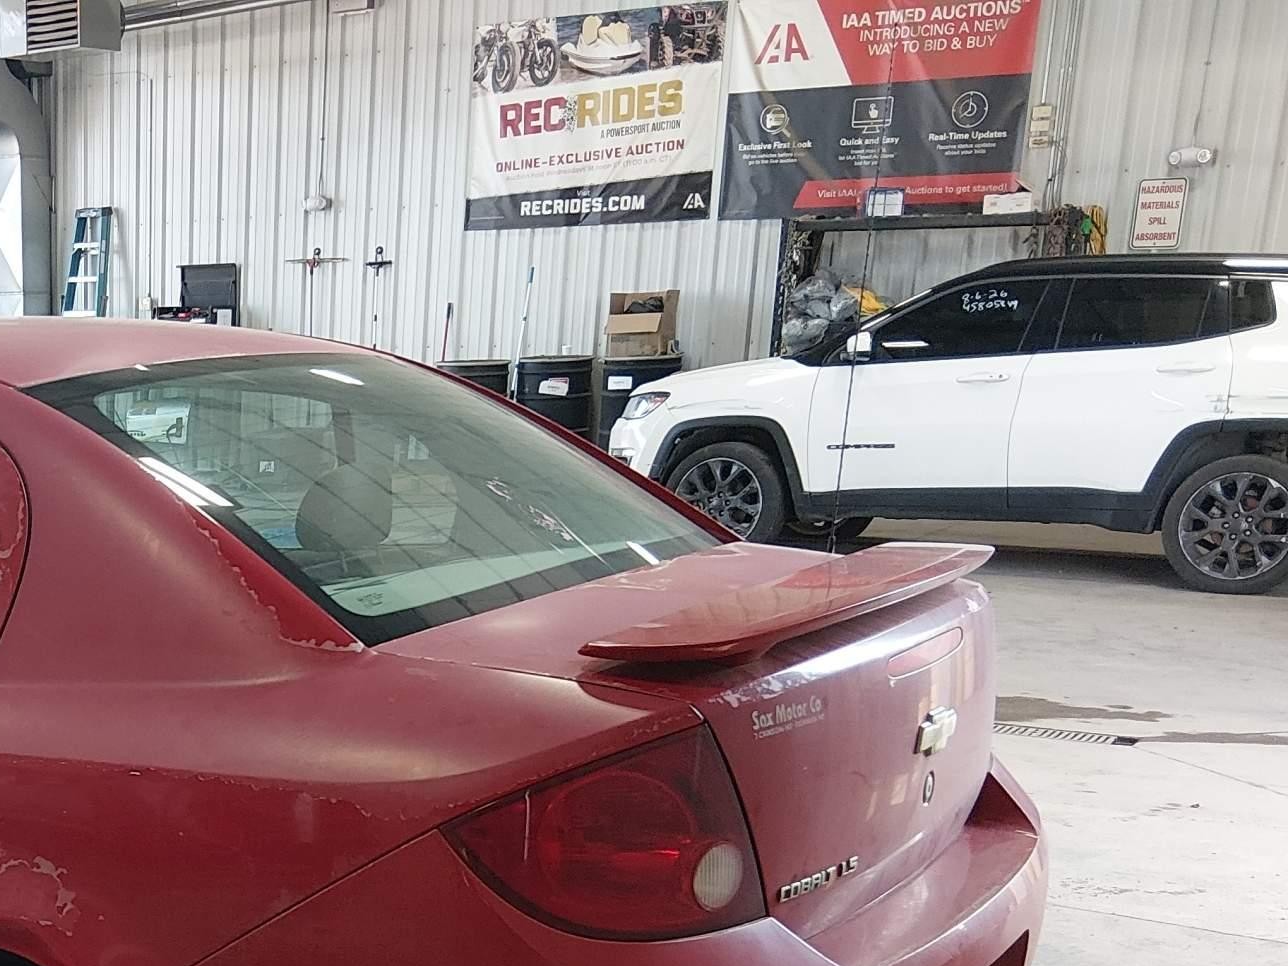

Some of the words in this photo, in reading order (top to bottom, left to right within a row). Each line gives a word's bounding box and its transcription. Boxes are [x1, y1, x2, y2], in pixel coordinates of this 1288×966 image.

[842, 12, 872, 28] IAA
[875, 8, 926, 25] TIMED
[930, 0, 1022, 21] AUCTIONS
[859, 23, 955, 42] INTRODUCING
[958, 23, 969, 34] A
[974, 18, 1009, 33] NEW
[868, 42, 899, 56] WAY
[902, 40, 920, 53] TO
[924, 38, 947, 52] BID
[951, 37, 962, 50] &
[966, 33, 998, 49] BUY
[499, 96, 567, 139] REC
[576, 79, 683, 129] RIDES
[606, 124, 649, 138] POWERSPORT
[651, 119, 681, 132] AUCTION
[928, 132, 969, 142] Real-Time
[971, 130, 1008, 140] Updates
[738, 142, 772, 151] Exclusive
[773, 141, 791, 150] First
[792, 139, 813, 149] Look
[839, 137, 863, 146] Quick
[864, 136, 879, 145] and
[496, 147, 622, 173] ONLINE-EXCLUSIVE
[625, 138, 685, 156] AUCTION
[817, 189, 837, 198] Visit
[945, 185, 953, 193] to
[956, 184, 970, 195] get
[1141, 184, 1183, 195] HAZARDOUS
[520, 195, 645, 216] RECRIDES.COM
[1140, 200, 1180, 210] MATERIALS
[1148, 216, 1167, 226] SPILL
[1135, 231, 1176, 242] ABSORBENT
[752, 710, 774, 730] Sax
[776, 703, 807, 724] Motor
[809, 695, 822, 713] Co
[779, 865, 837, 903] COBALT
[841, 855, 859, 876] LS
